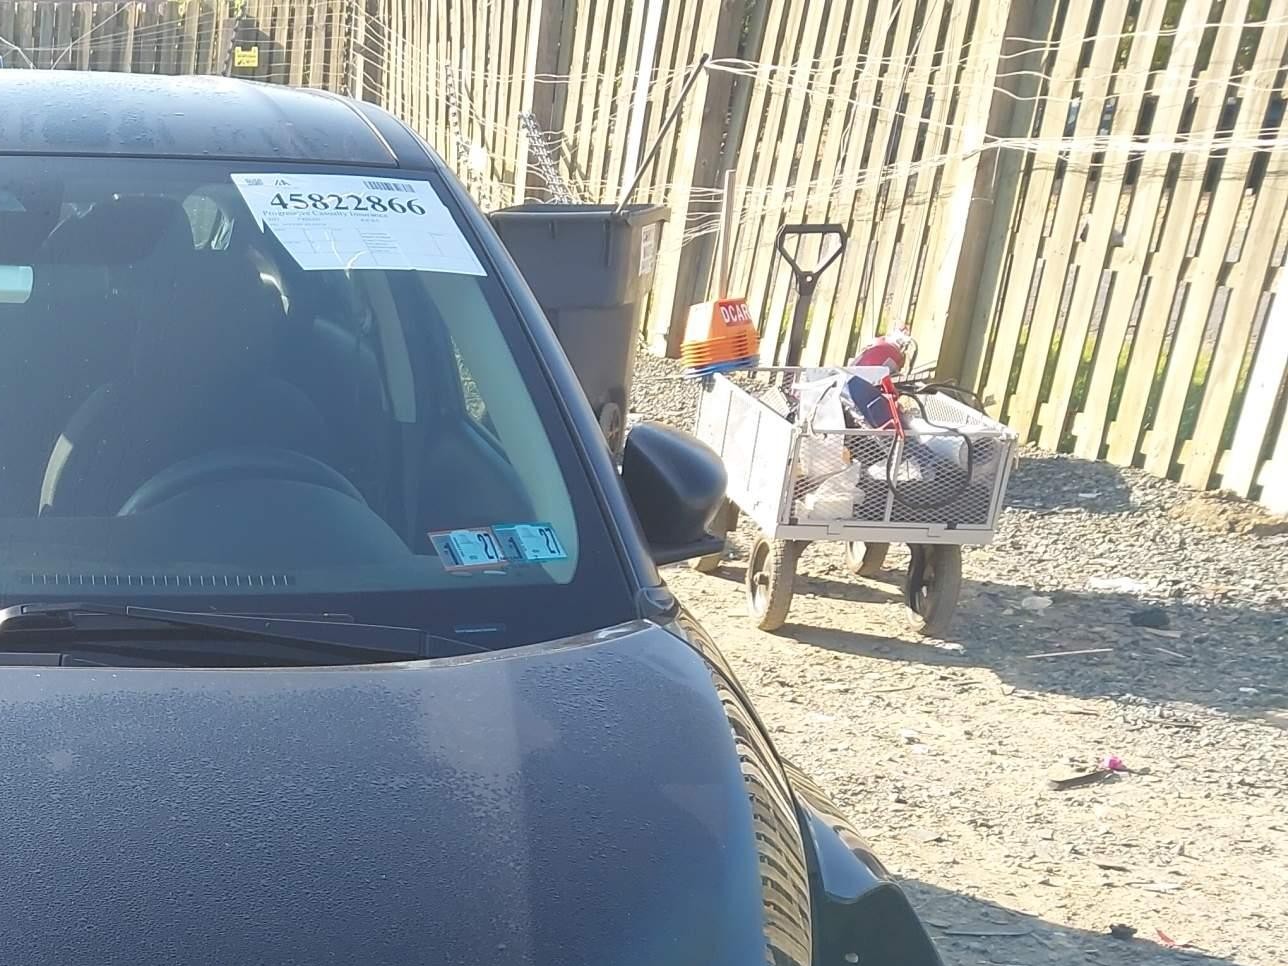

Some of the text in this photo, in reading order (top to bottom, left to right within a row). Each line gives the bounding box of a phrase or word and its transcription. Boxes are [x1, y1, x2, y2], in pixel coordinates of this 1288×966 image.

[270, 192, 427, 216] 45822866
[312, 210, 347, 218] Casualty
[477, 533, 500, 562] 27
[539, 527, 562, 556] 27
